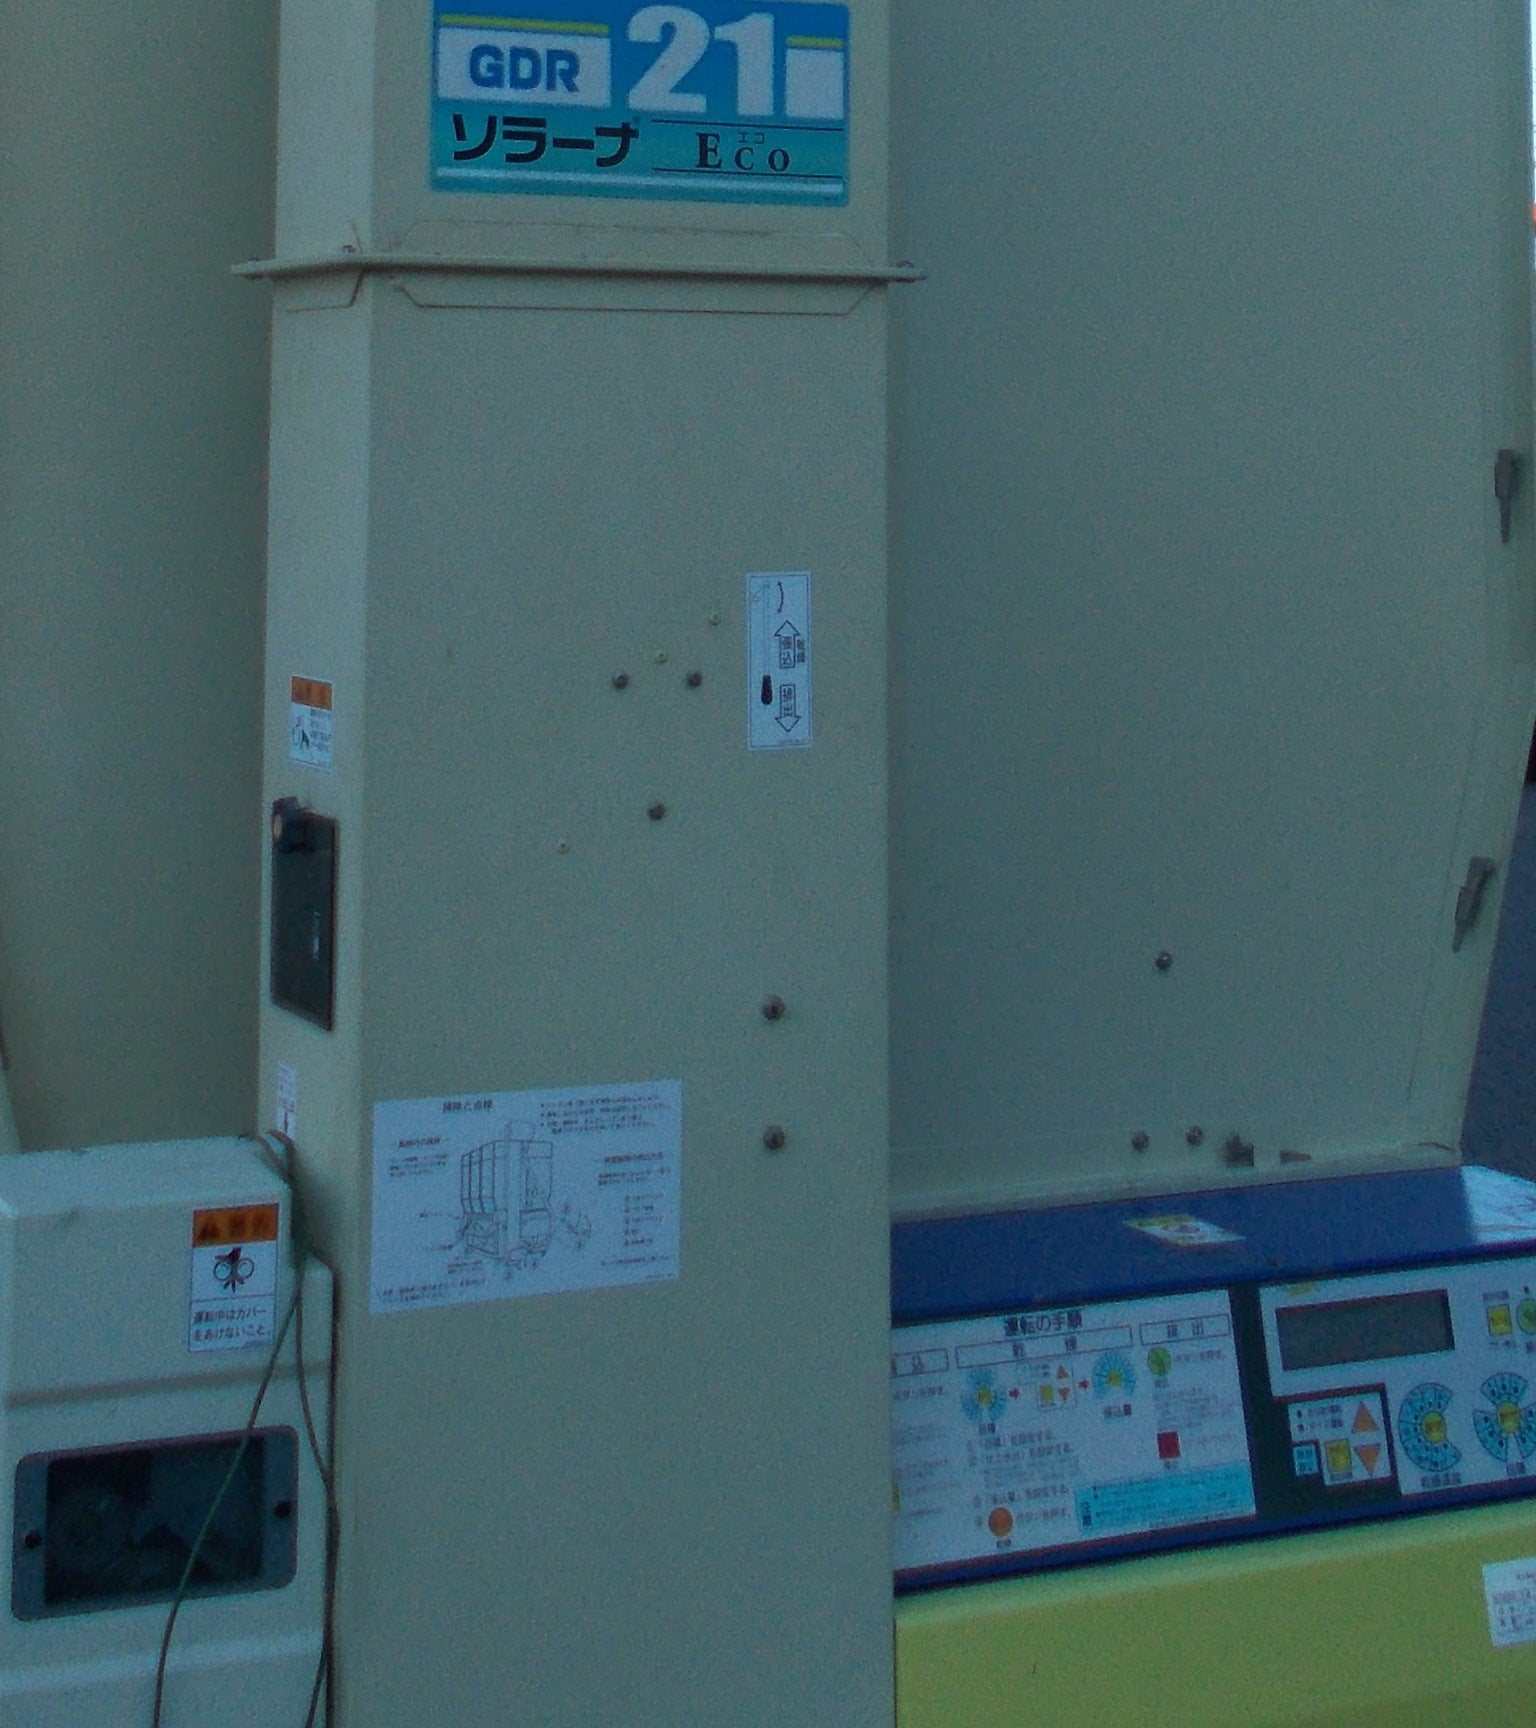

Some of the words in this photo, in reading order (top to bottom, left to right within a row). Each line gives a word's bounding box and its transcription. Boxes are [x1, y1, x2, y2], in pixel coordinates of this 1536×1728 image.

[469, 44, 581, 93] GDR
[627, 4, 775, 117] 21
[452, 113, 639, 168] ソラーナ
